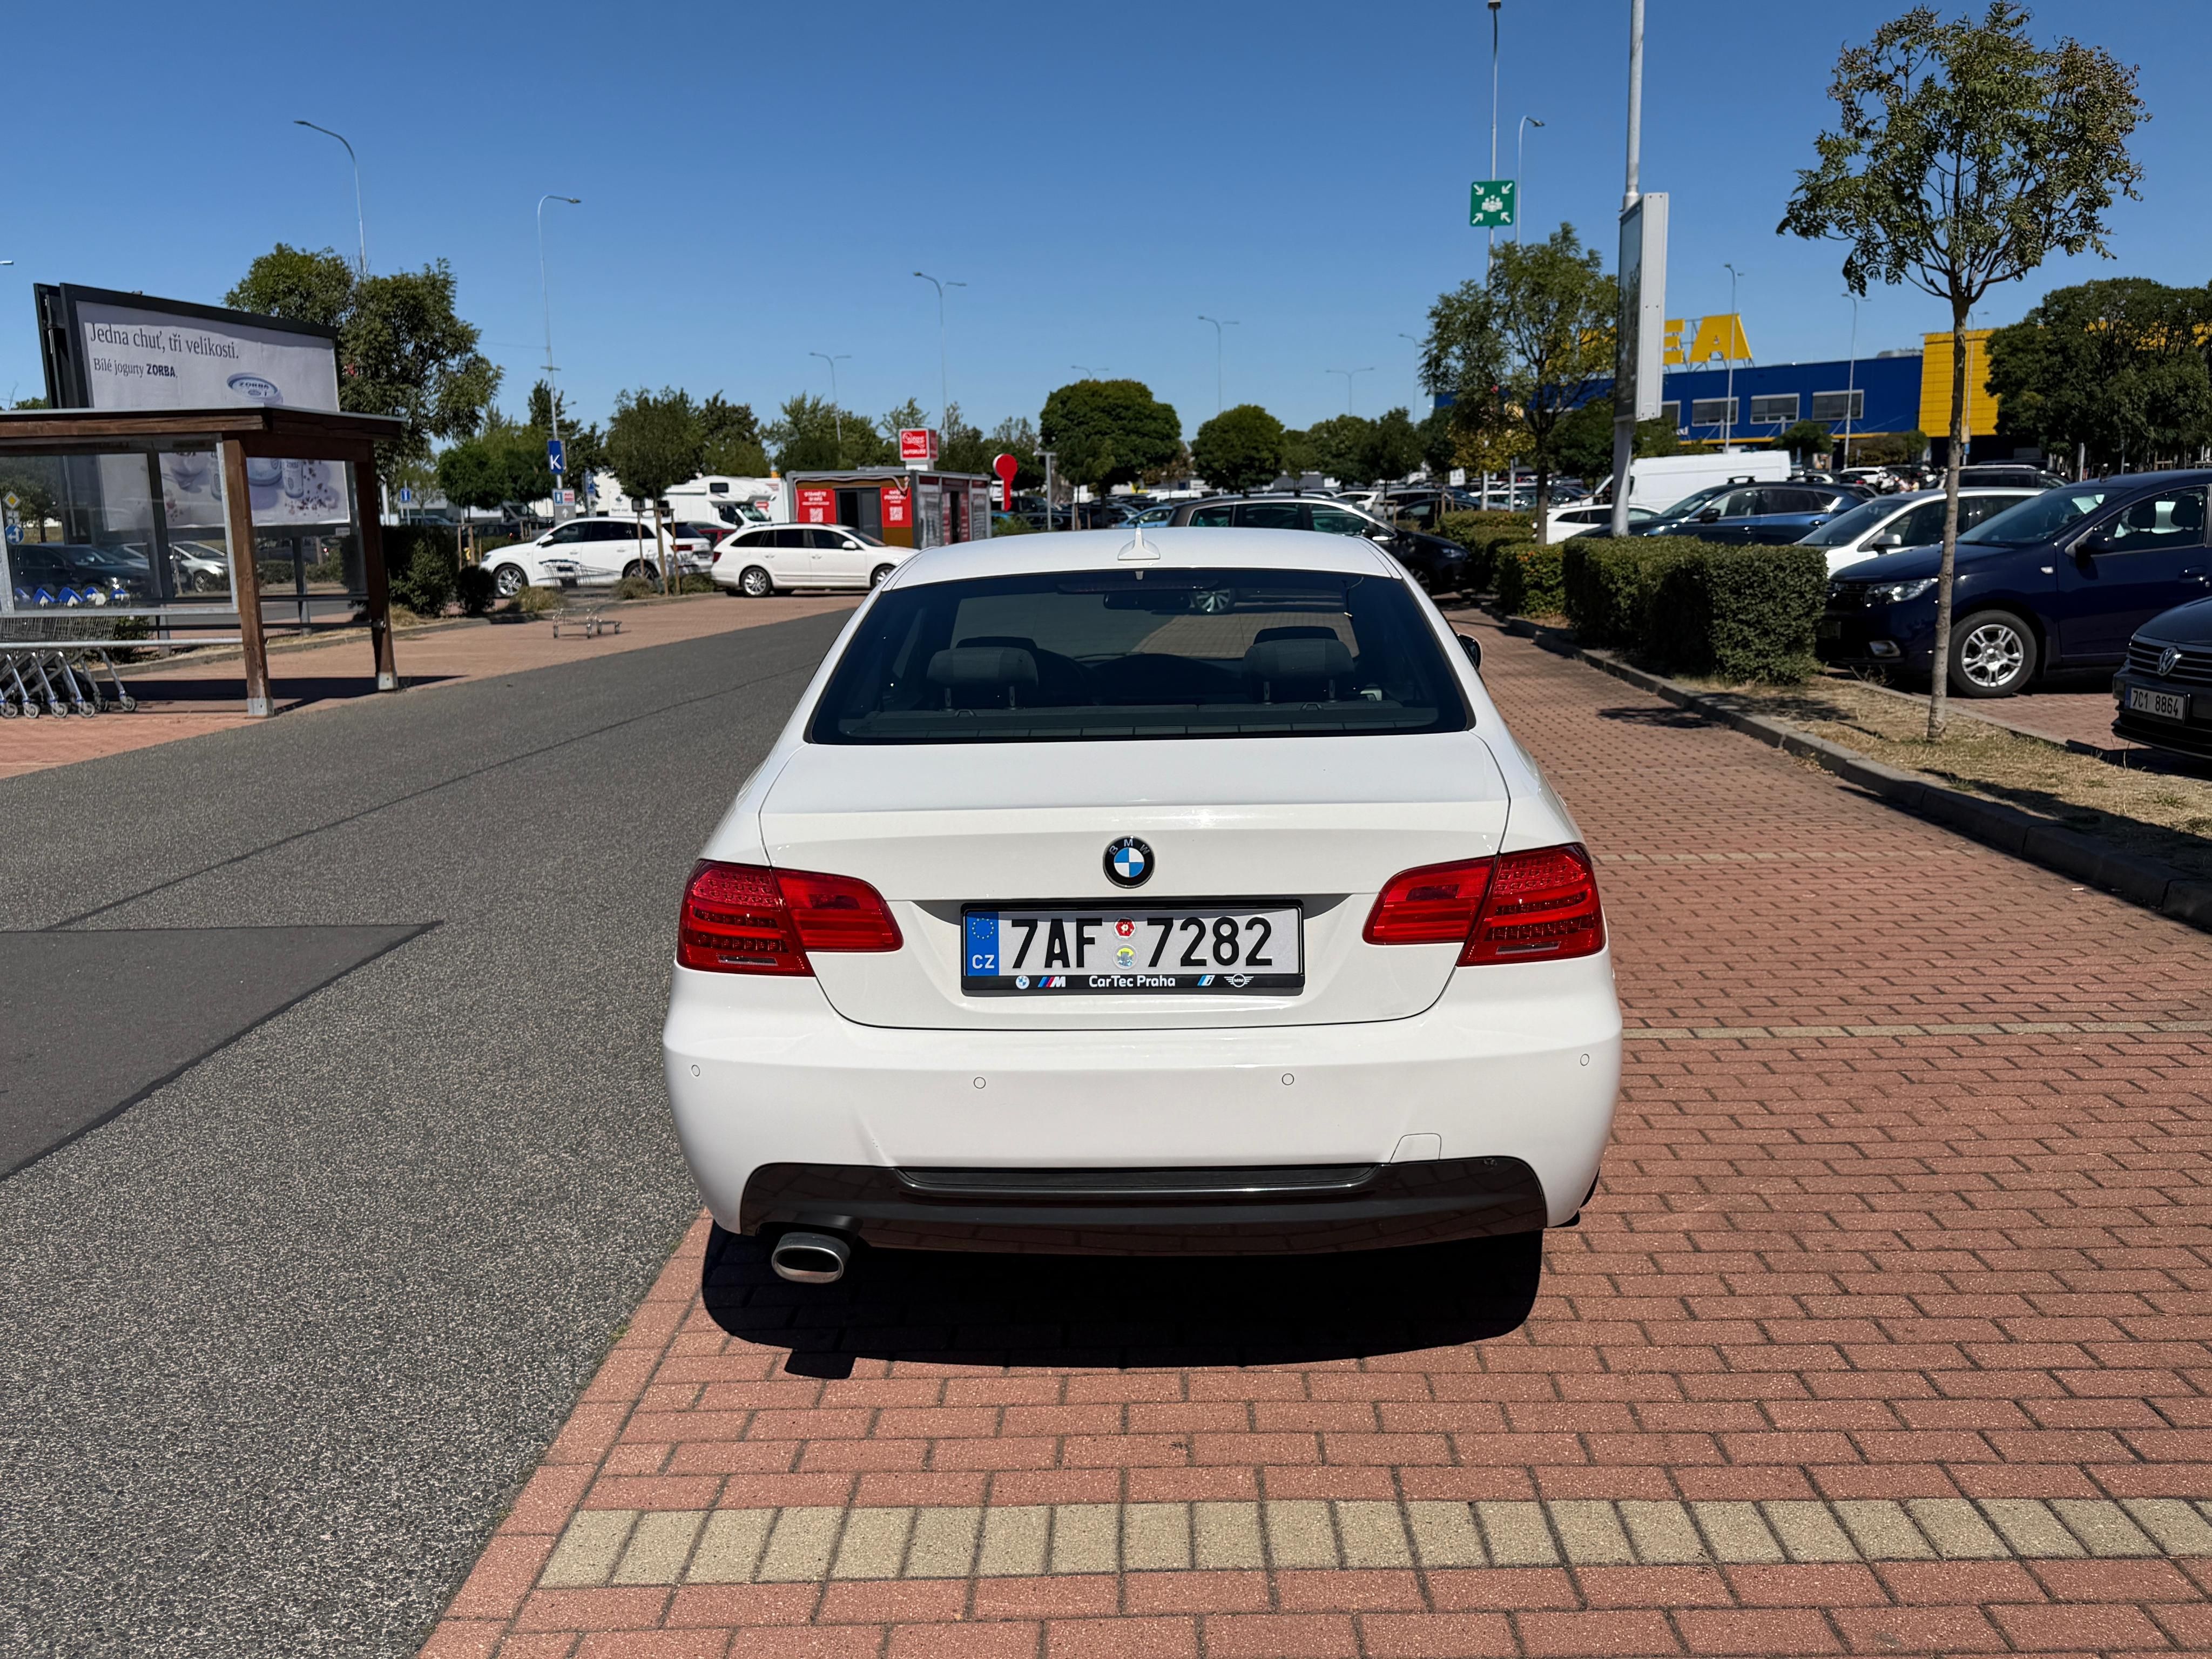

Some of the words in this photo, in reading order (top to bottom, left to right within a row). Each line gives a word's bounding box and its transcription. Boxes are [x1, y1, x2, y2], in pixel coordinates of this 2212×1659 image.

[91, 323, 129, 346] Jedna
[133, 327, 165, 354] chuť,
[169, 333, 182, 353] tři
[185, 337, 239, 359] velikosti.
[94, 358, 112, 372] Bílé
[114, 360, 144, 379] jogurty
[550, 454, 562, 470] K
[2133, 690, 2148, 710] 7C1
[2155, 694, 2179, 717] 8864
[1109, 839, 1150, 855] BMW
[1011, 918, 1103, 969] 7AF
[1147, 916, 1273, 967] 7282
[972, 954, 995, 969] CZ
[1089, 975, 1134, 988] CarTec
[1137, 975, 1176, 987] Praha
